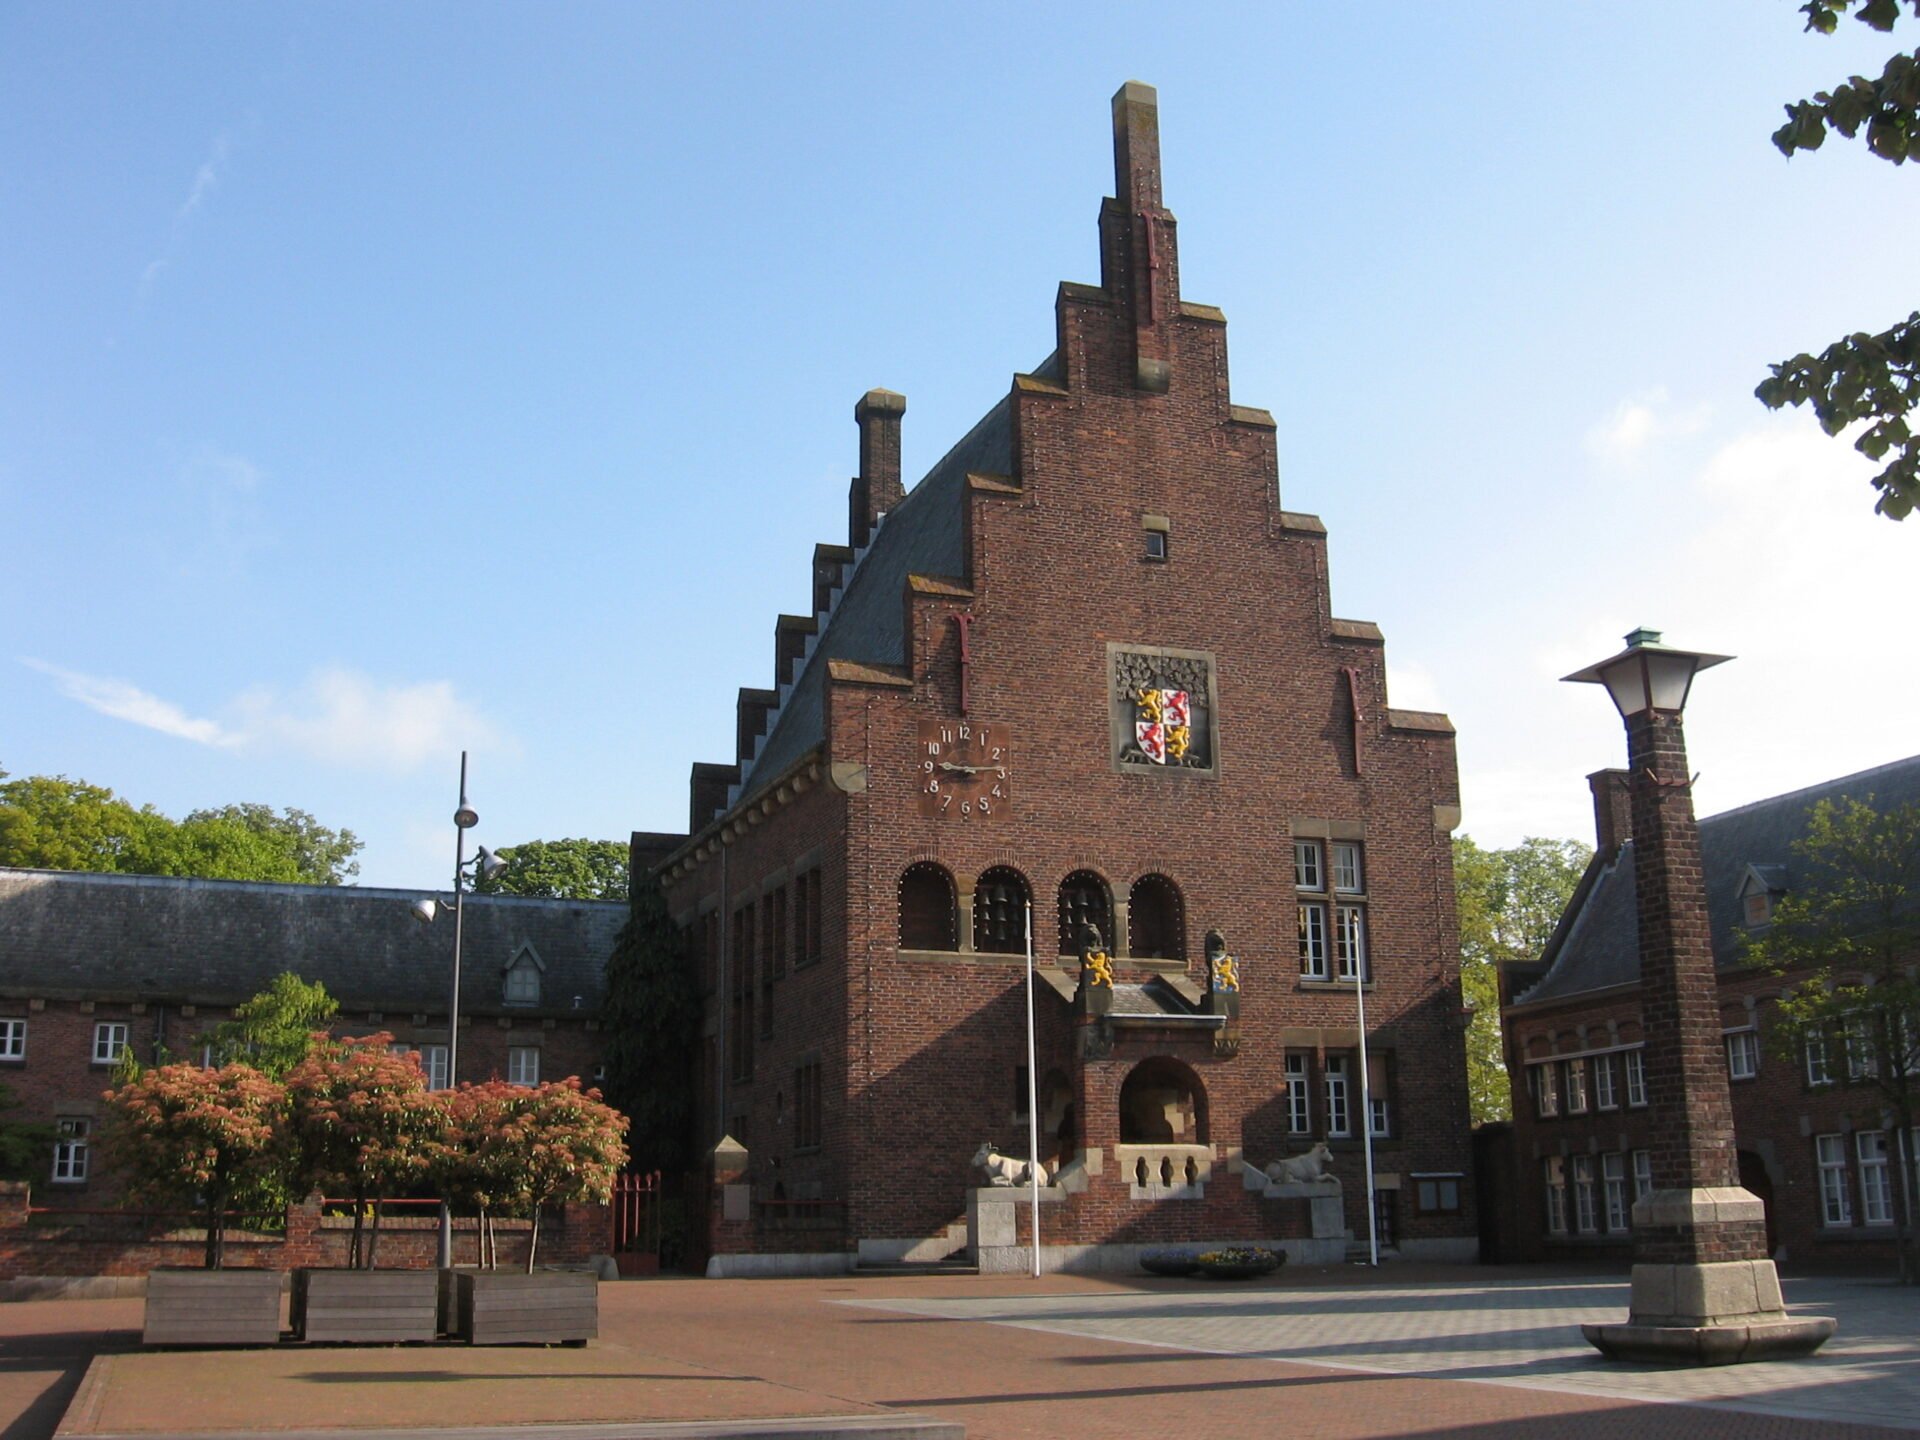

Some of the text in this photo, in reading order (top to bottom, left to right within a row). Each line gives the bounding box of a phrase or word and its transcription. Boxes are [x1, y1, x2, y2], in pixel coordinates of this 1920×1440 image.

[942, 730, 952, 743] 11
[960, 726, 970, 740] 12
[981, 733, 985, 746] 1
[928, 742, 940, 755] 10
[992, 747, 1000, 760] 2
[924, 761, 934, 774] 9
[997, 766, 1006, 779] 3
[929, 780, 939, 793] 8
[992, 785, 1001, 798] 4
[943, 795, 952, 808] 7
[961, 801, 971, 814] 6
[979, 797, 989, 810] 5
